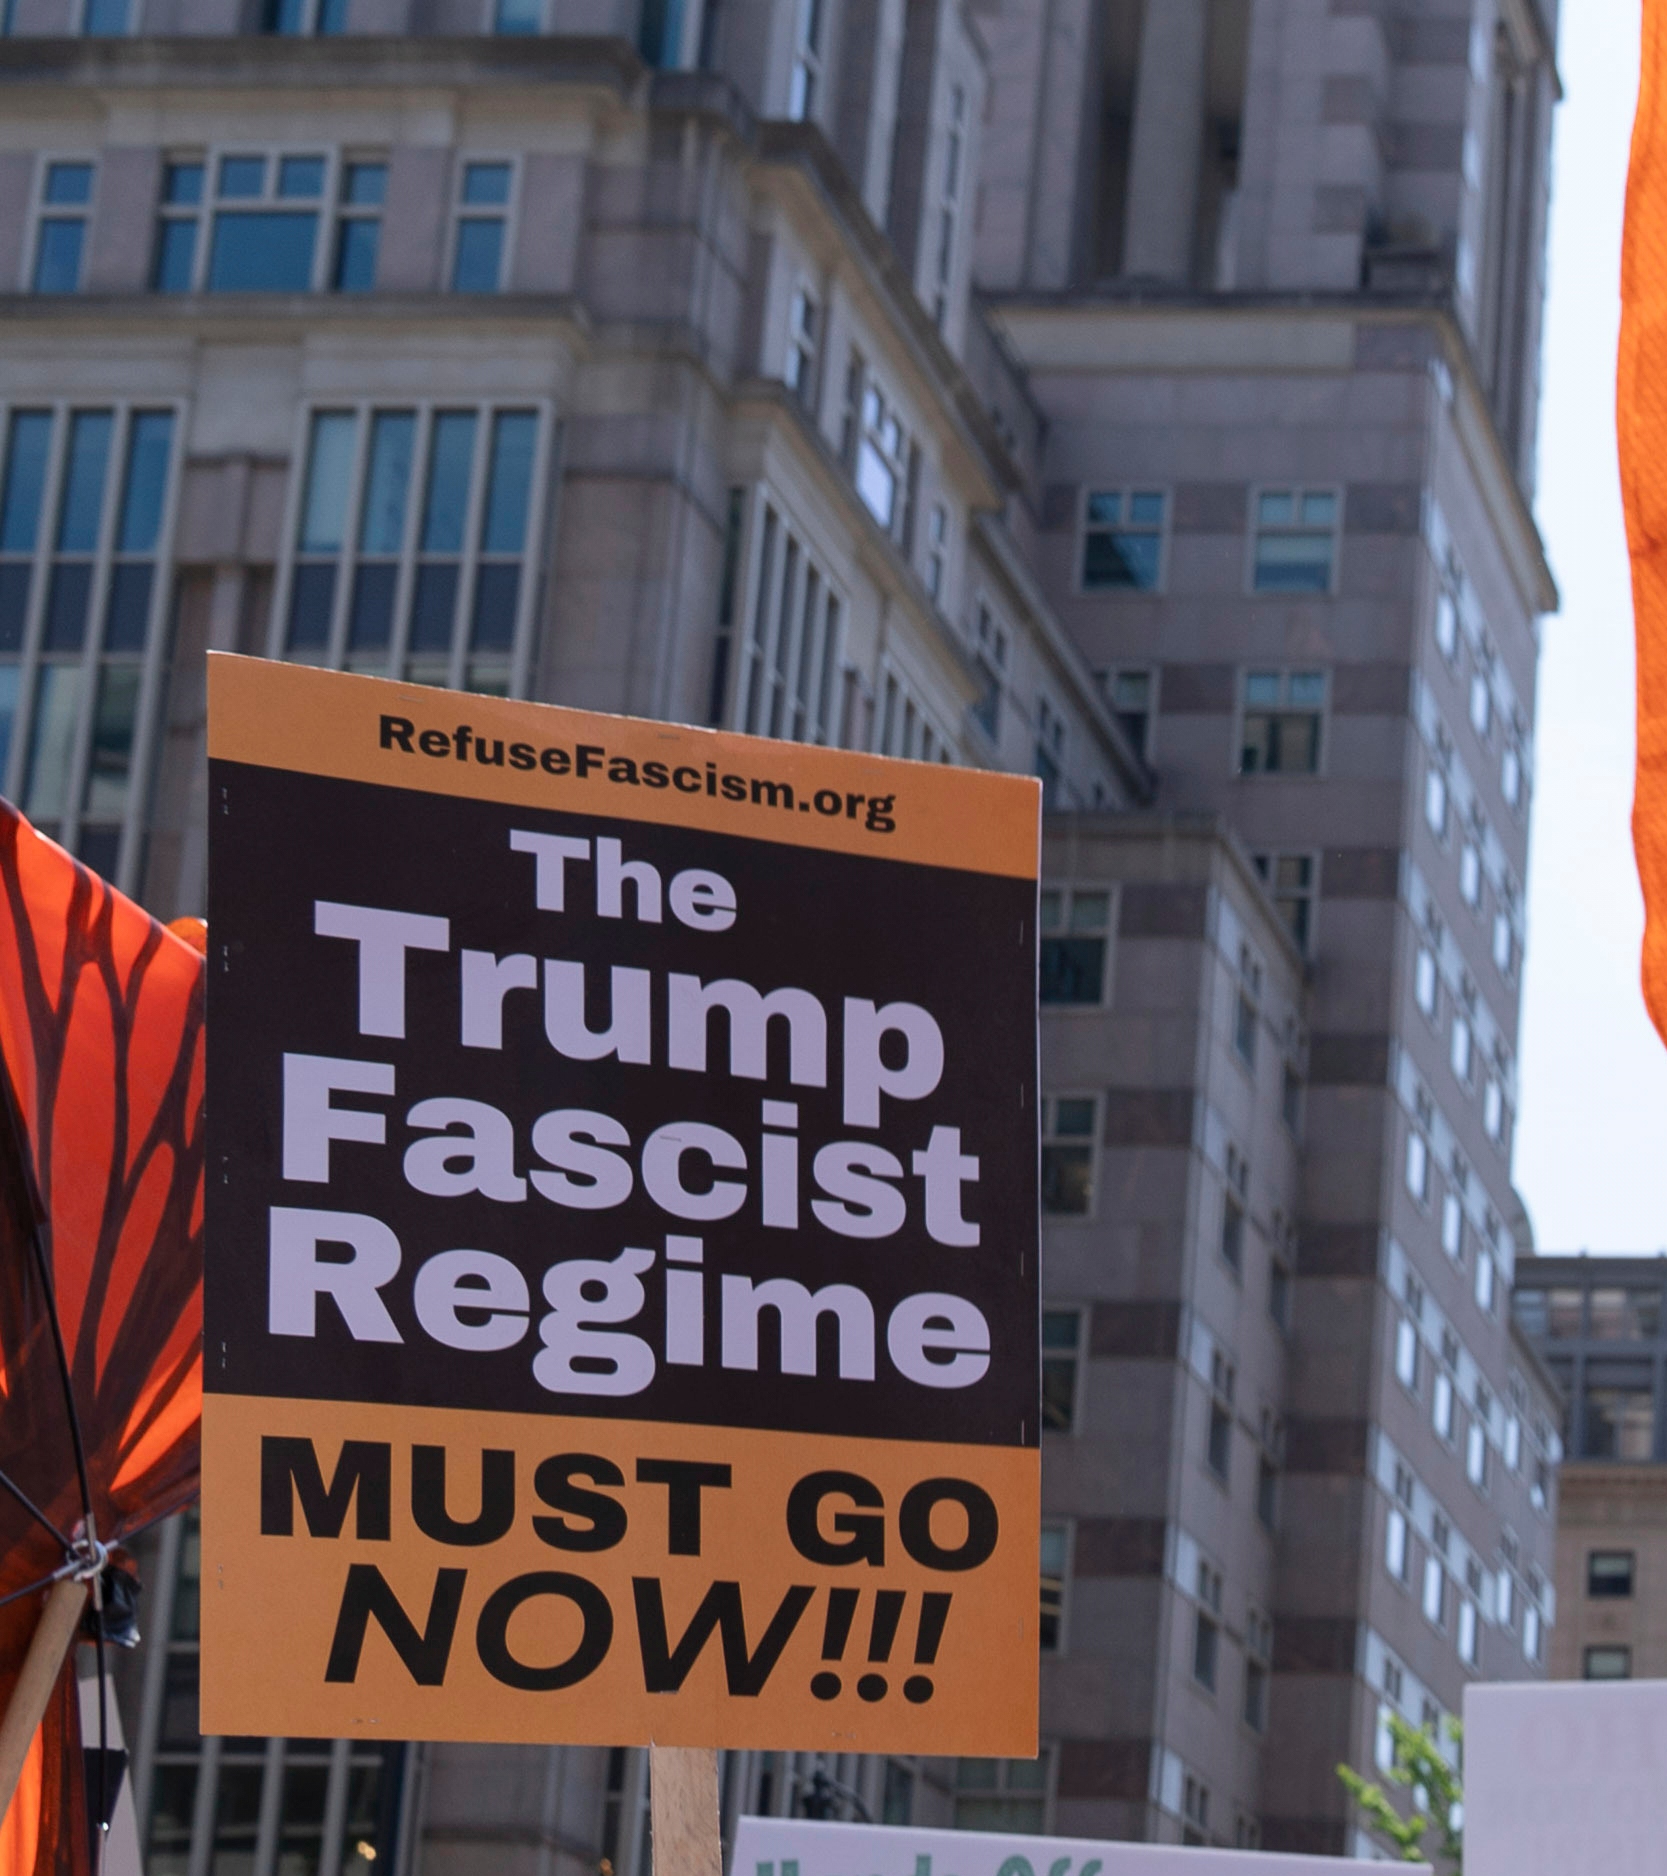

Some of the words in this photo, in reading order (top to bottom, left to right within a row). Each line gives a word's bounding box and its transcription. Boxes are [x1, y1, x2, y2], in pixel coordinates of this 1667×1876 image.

[378, 713, 897, 834] RefuseFascism.org
[509, 828, 738, 932] The
[313, 900, 946, 1129] Trump
[281, 1052, 981, 1248] Fascist
[268, 1205, 992, 1398] Regime
[259, 1434, 734, 1558] MUST
[785, 1469, 1000, 1572] GO
[323, 1562, 954, 1705] NOW!!!
